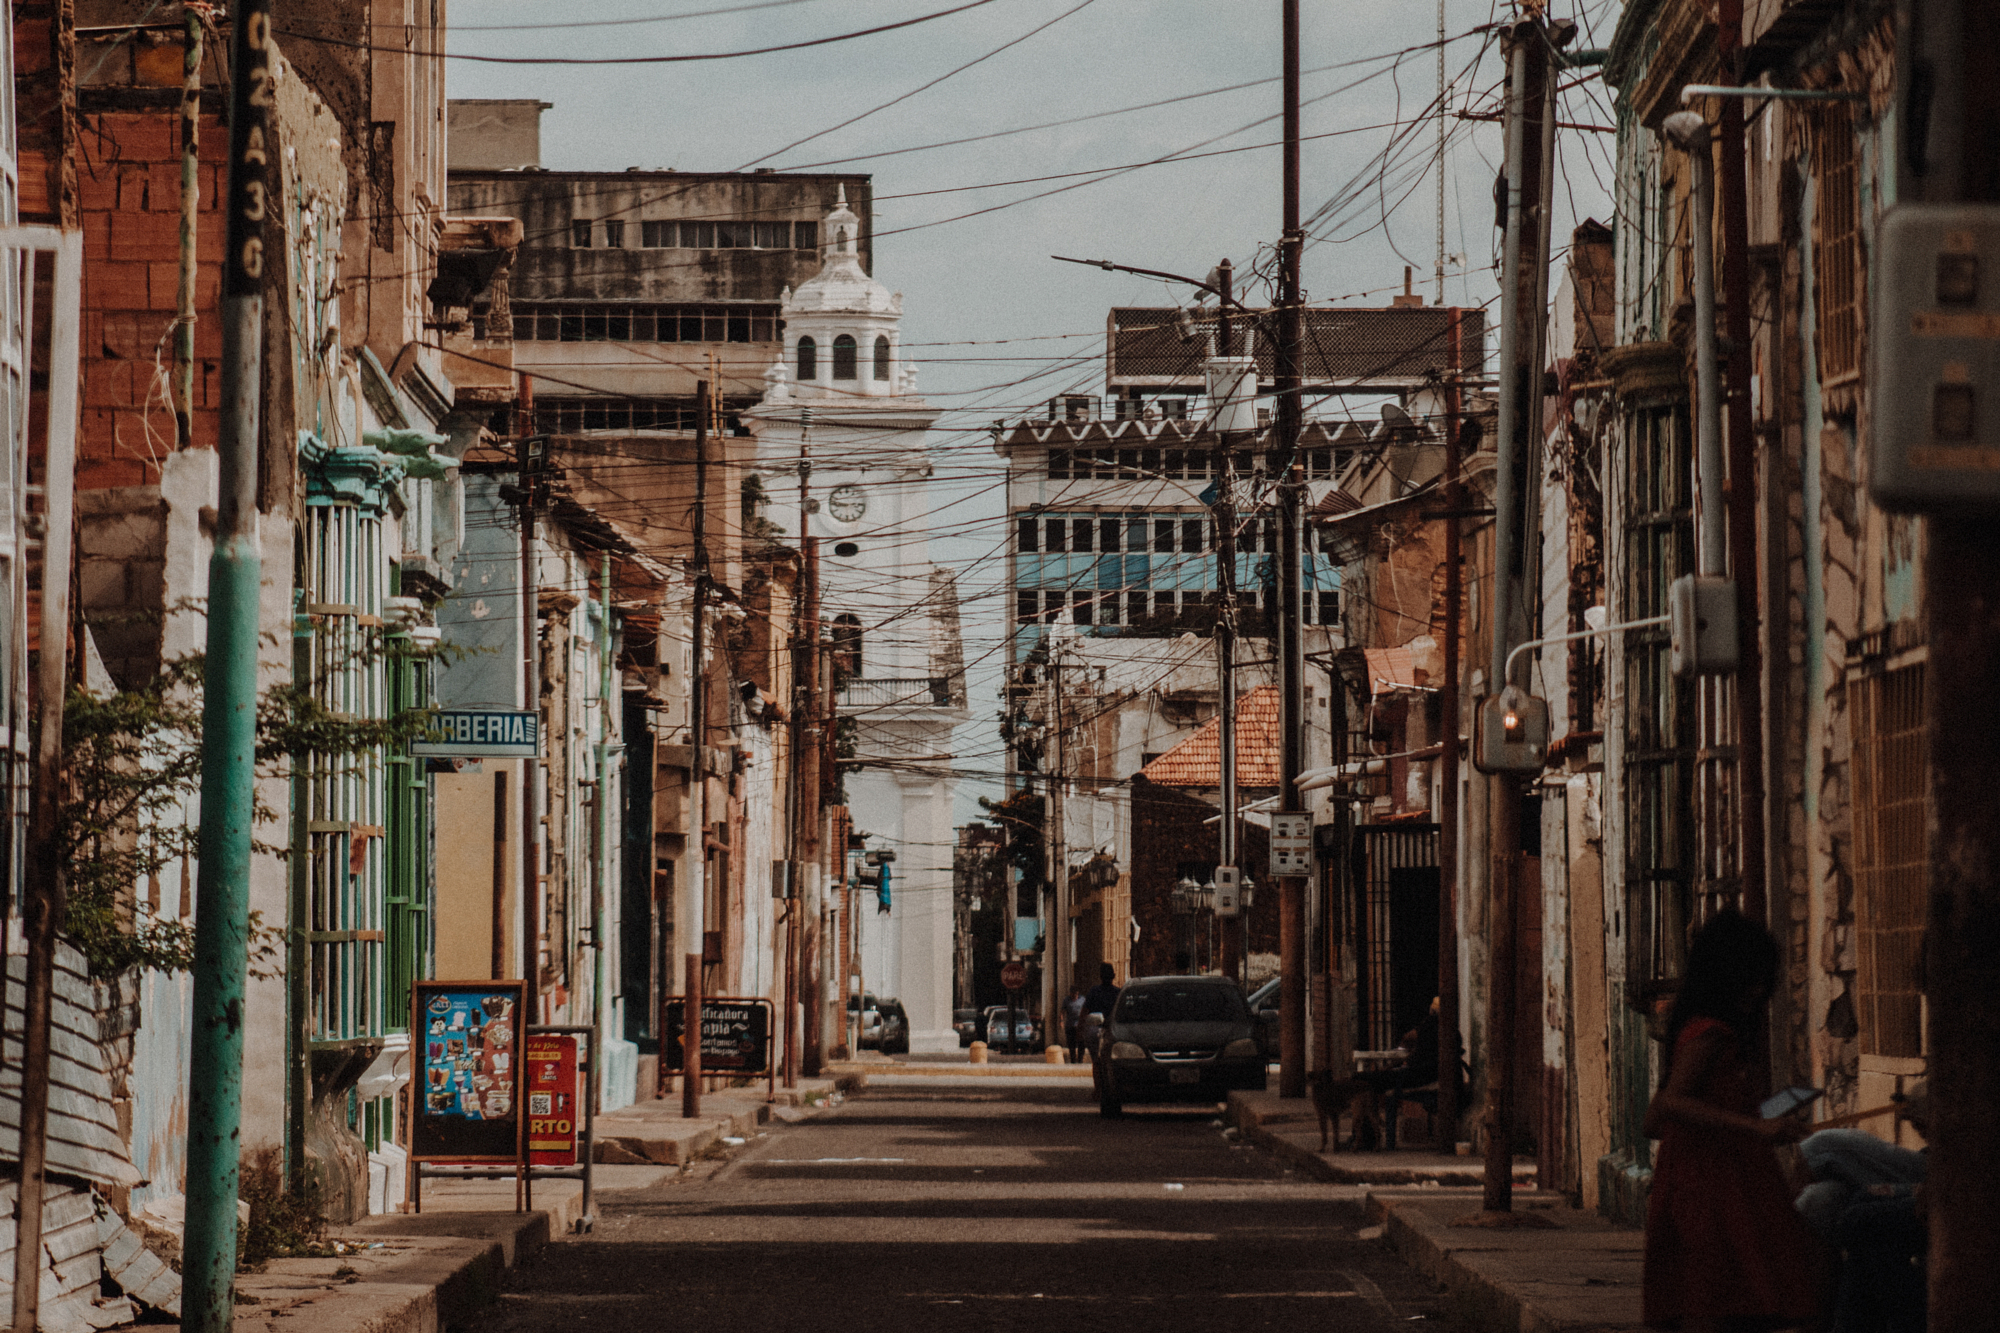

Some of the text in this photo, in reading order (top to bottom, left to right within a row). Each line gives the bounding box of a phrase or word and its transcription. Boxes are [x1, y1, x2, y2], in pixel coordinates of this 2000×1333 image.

[416, 715, 525, 742] ARBERIA
[1003, 971, 1023, 980] PARE
[701, 1006, 749, 1020] ificadora
[702, 1020, 730, 1036] apia
